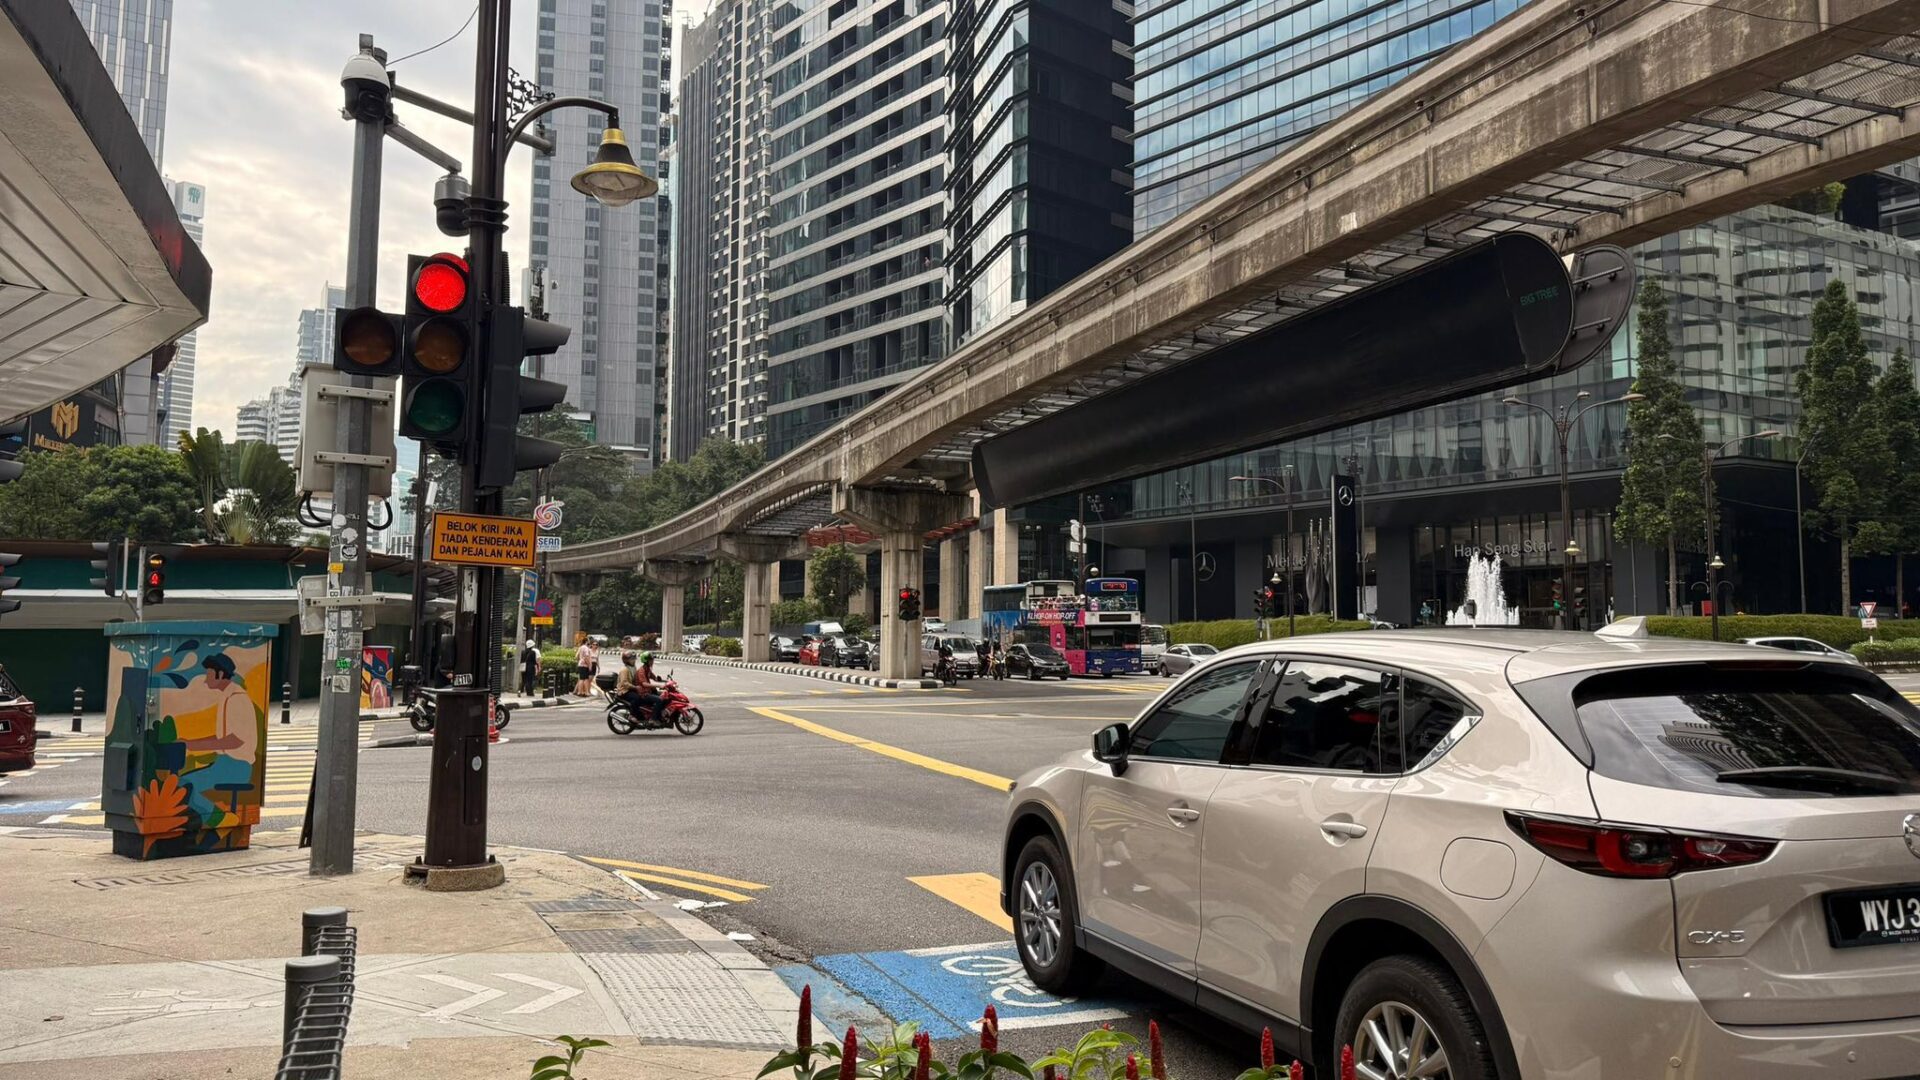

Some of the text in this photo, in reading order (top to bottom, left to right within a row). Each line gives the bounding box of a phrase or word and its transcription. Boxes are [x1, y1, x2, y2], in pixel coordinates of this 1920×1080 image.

[447, 521, 523, 536] BELOK KIRI JIKA
[441, 533, 468, 544] TIADA
[472, 535, 528, 548] KENDERAAN
[538, 537, 560, 545] SEAN
[439, 545, 528, 560] DAN PEJALAN KAKI
[1484, 542, 1519, 558] Seng
[1523, 539, 1553, 553] Star
[1688, 930, 1745, 944] CX-5
